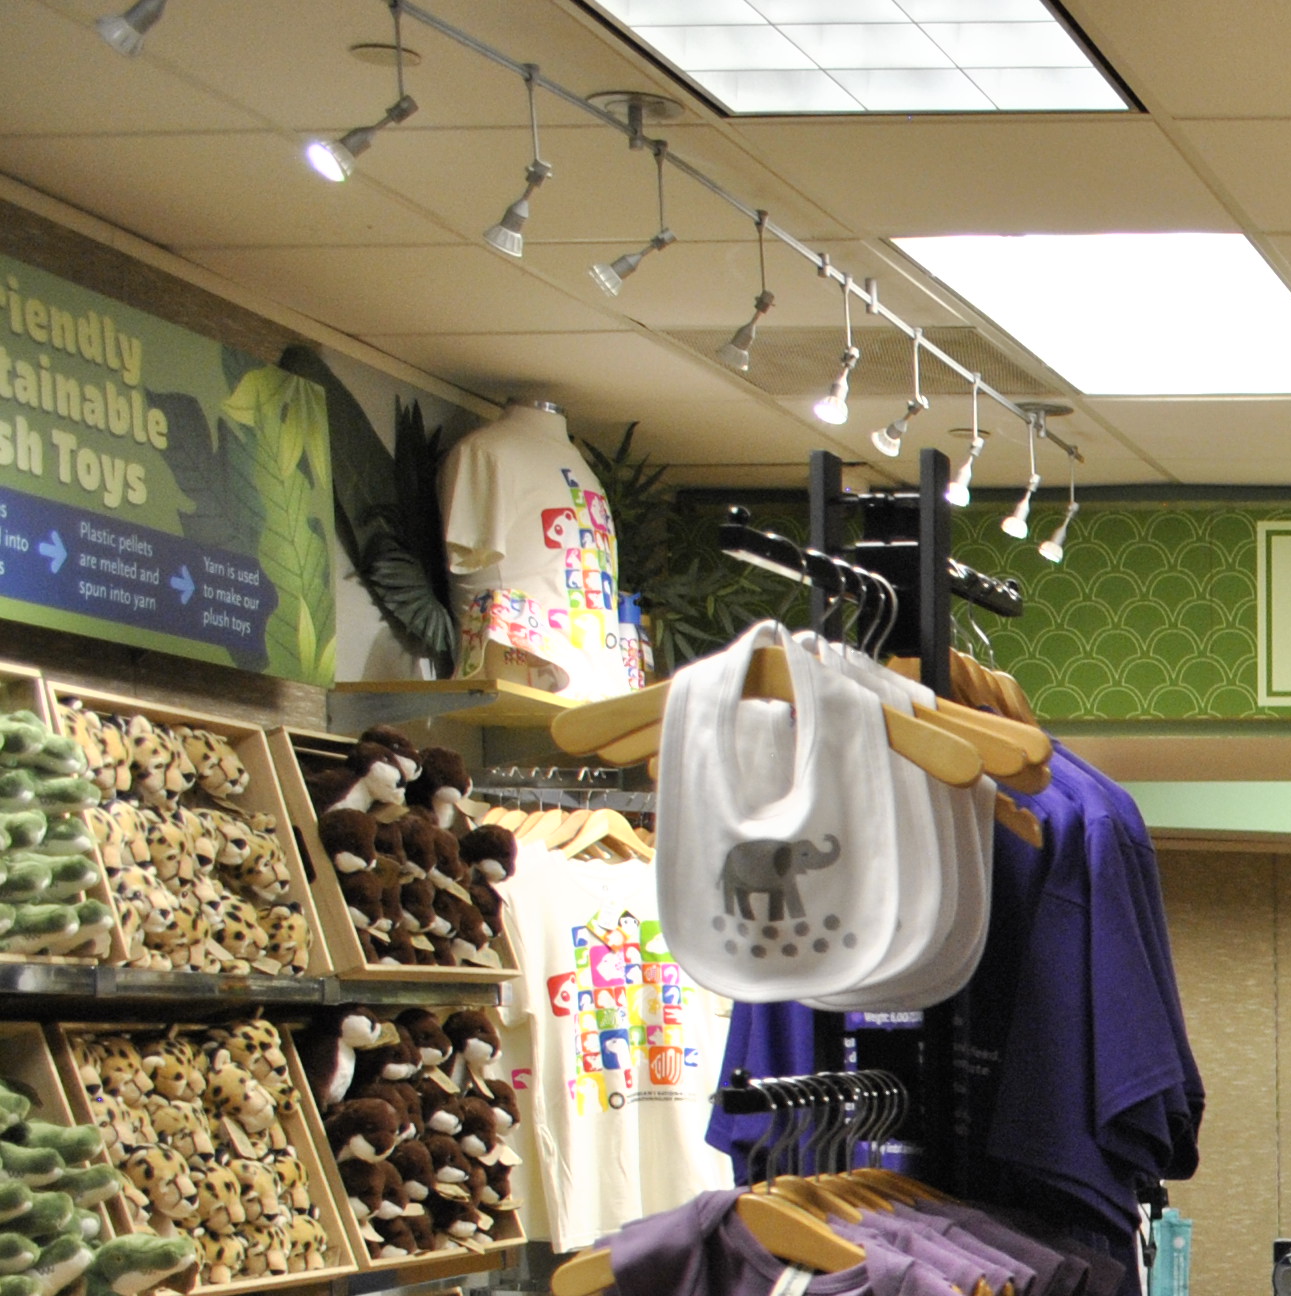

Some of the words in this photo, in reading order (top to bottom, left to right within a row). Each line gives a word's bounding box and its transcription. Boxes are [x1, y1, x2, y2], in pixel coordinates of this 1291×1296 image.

[52, 429, 147, 509] Toys
[5, 530, 29, 552] into
[80, 521, 117, 547] Plastic
[118, 533, 153, 557] pellets
[79, 553, 97, 569] are
[100, 558, 137, 580] melted
[140, 568, 160, 585] and
[203, 556, 225, 577] Yarn
[227, 563, 235, 580] is
[238, 569, 260, 586] used
[79, 580, 107, 600] spun
[110, 584, 131, 605] into
[133, 593, 156, 611] yarn
[203, 583, 214, 599] to
[216, 588, 241, 607] make
[243, 597, 260, 610] our
[203, 607, 230, 628] plush
[232, 615, 251, 636] toys
